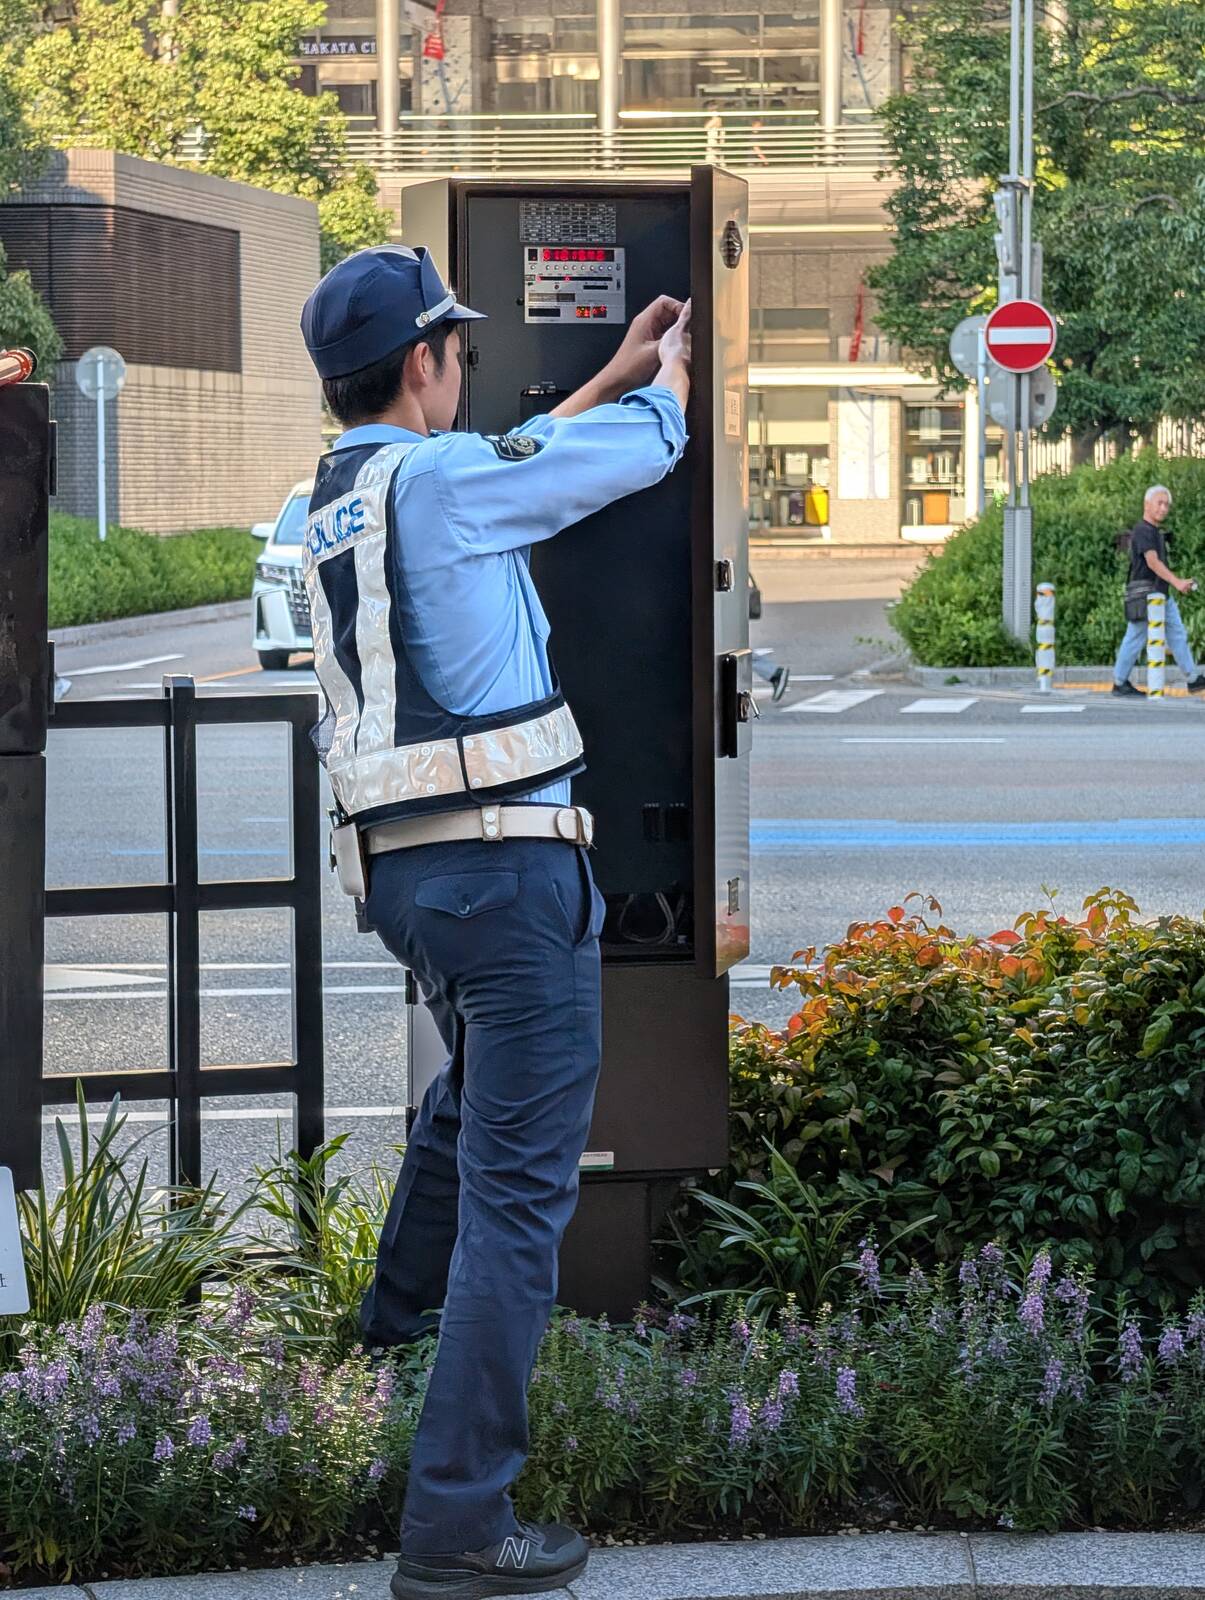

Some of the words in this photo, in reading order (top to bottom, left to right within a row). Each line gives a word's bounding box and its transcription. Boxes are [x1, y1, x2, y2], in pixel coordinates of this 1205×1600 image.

[299, 42, 357, 54] HAKATA
[306, 497, 365, 555] OLICE
[496, 1537, 530, 1568] N
